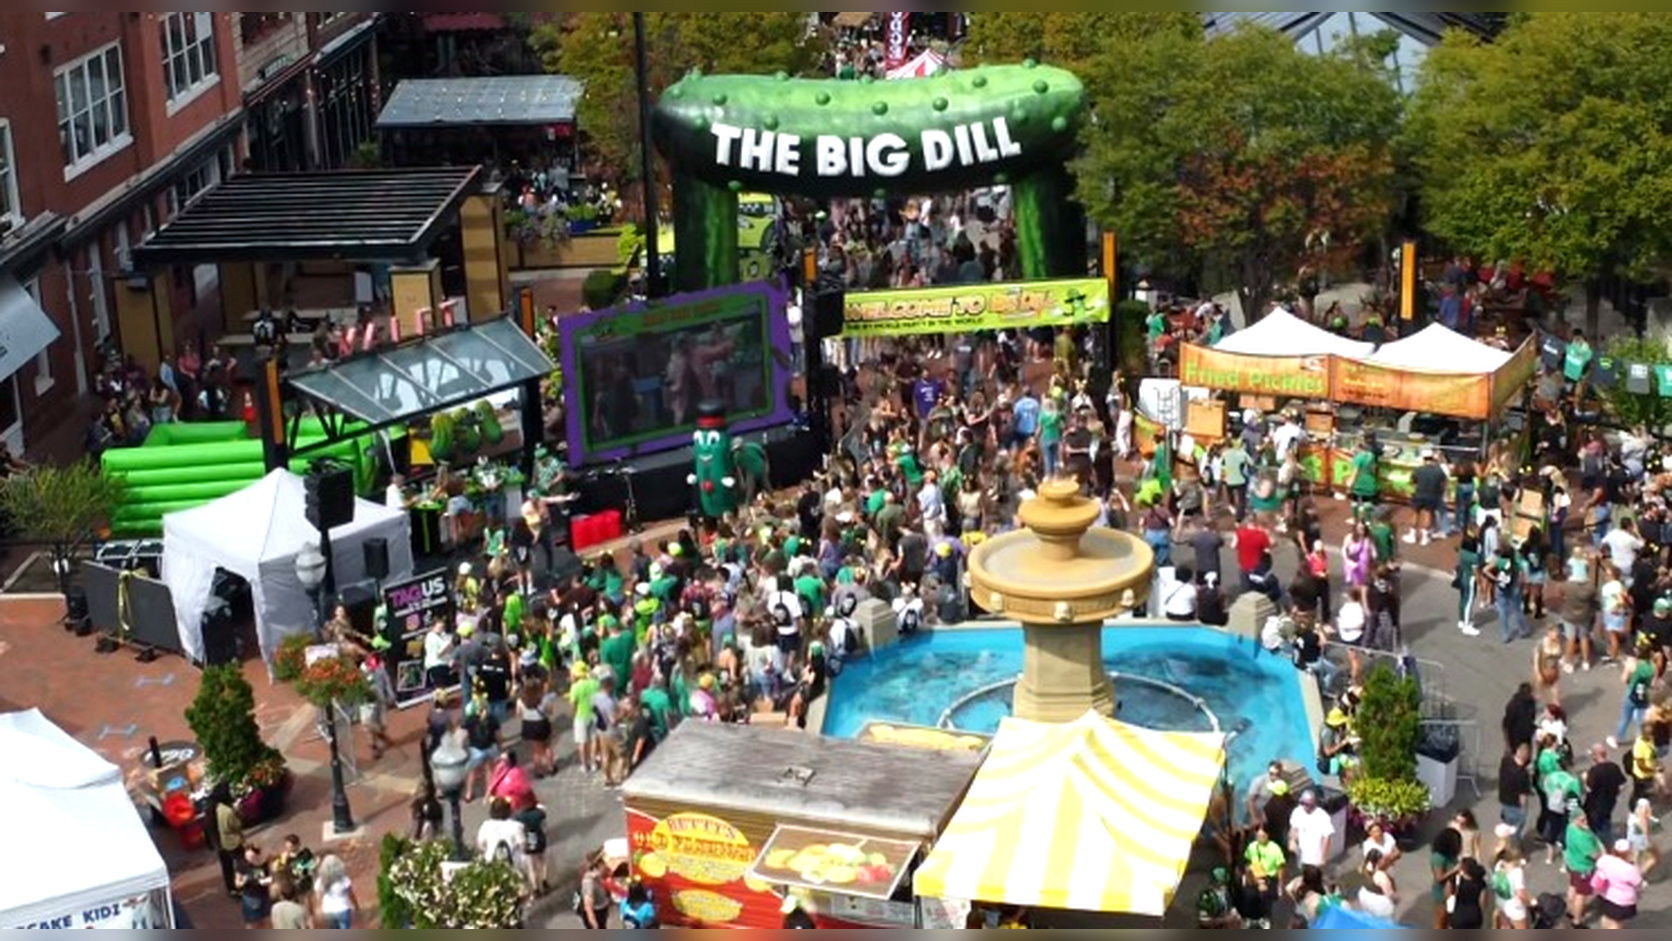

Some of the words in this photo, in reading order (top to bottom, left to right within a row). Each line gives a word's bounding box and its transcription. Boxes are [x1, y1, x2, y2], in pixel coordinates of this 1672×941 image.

[711, 122, 800, 176] THE
[816, 133, 910, 177] BIG
[920, 116, 1022, 172] DILL
[845, 297, 952, 321] WELCOME
[955, 294, 986, 315] TO
[1185, 361, 1239, 386] Fried
[1248, 368, 1323, 392] Pickles
[389, 584, 421, 606] TAG
[421, 577, 445, 597] US
[15, 914, 73, 929] AKE
[83, 903, 121, 923] KIDZ
